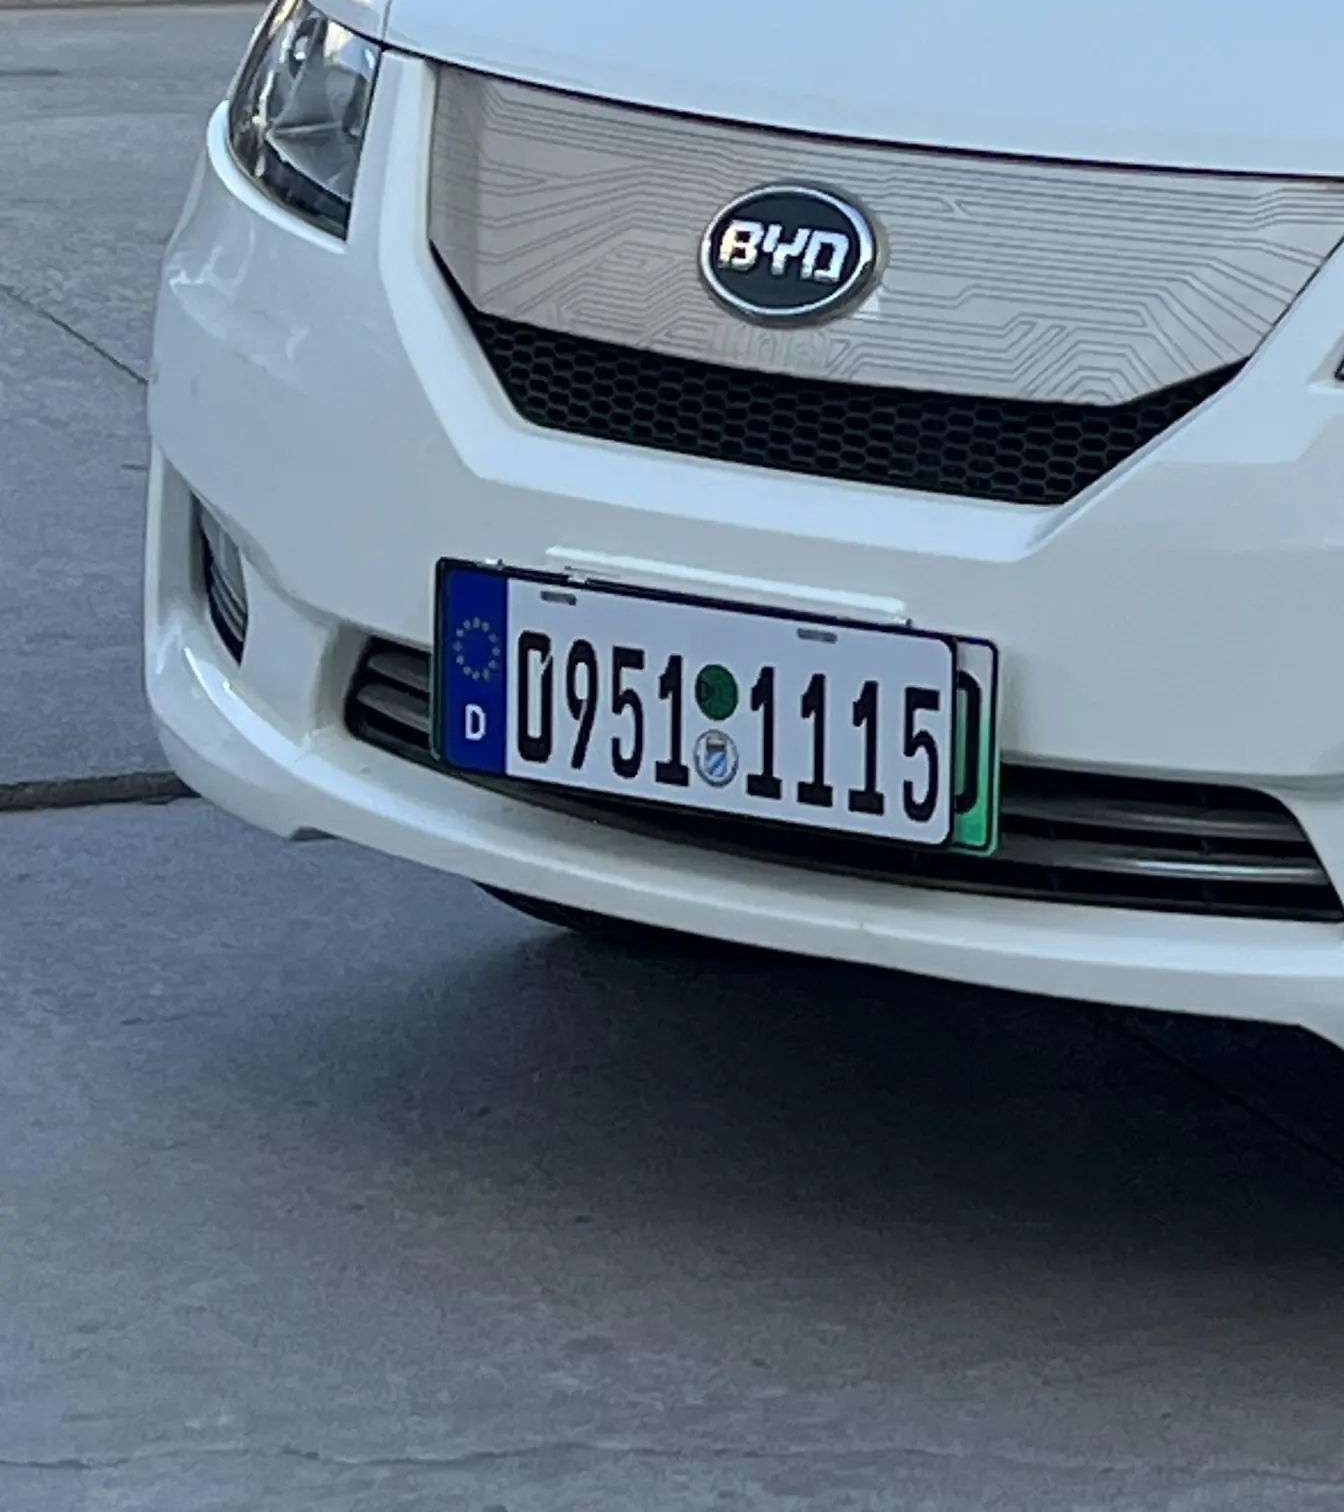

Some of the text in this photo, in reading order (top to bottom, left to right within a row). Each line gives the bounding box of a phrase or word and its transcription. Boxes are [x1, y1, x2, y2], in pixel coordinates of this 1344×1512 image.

[718, 218, 849, 283] BYD
[465, 703, 487, 742] D
[517, 629, 690, 787] 0951
[746, 665, 941, 823] 1115
